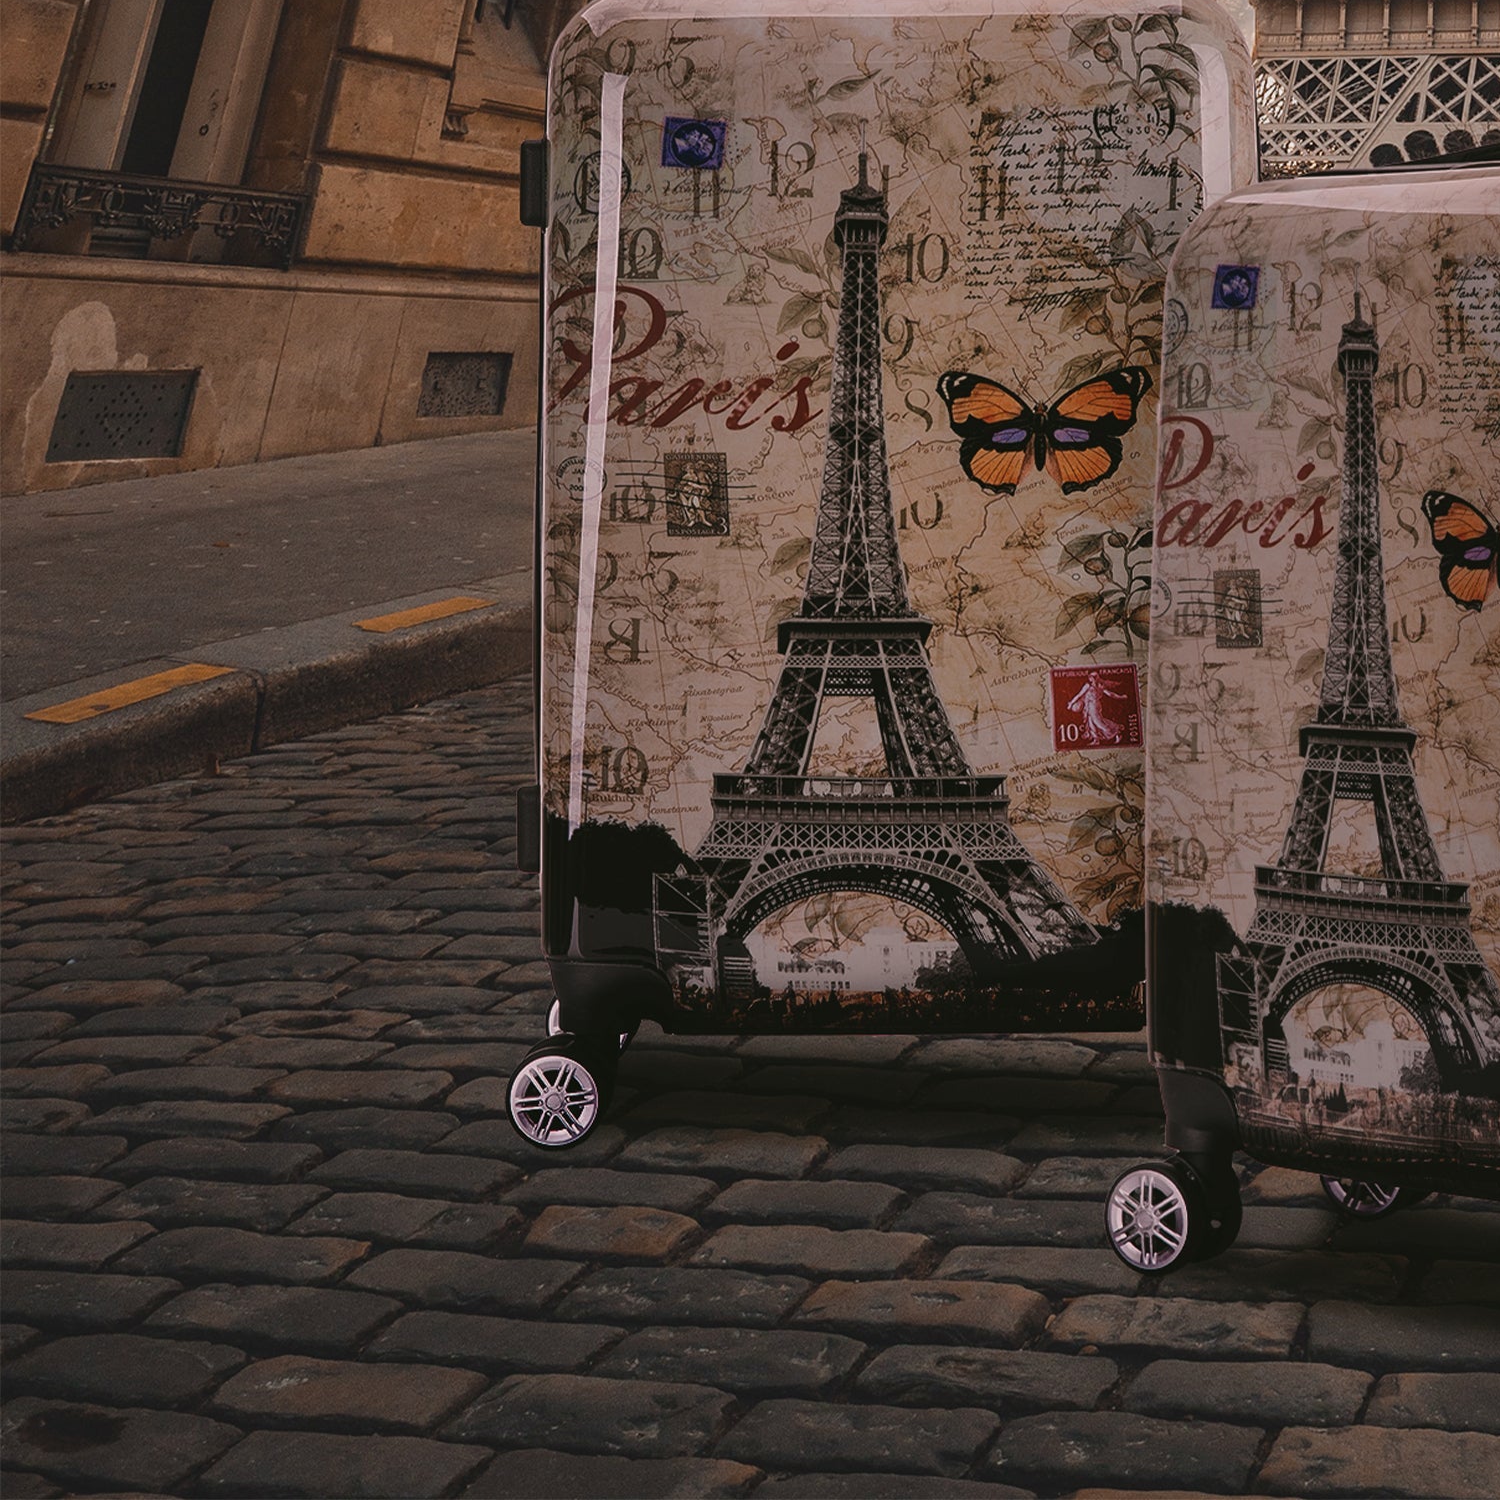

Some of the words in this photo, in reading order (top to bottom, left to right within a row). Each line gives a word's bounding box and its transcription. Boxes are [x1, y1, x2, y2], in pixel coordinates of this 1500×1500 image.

[546, 286, 824, 431] Paris
[747, 489, 796, 504] Moscow
[1155, 415, 1335, 549] Paris
